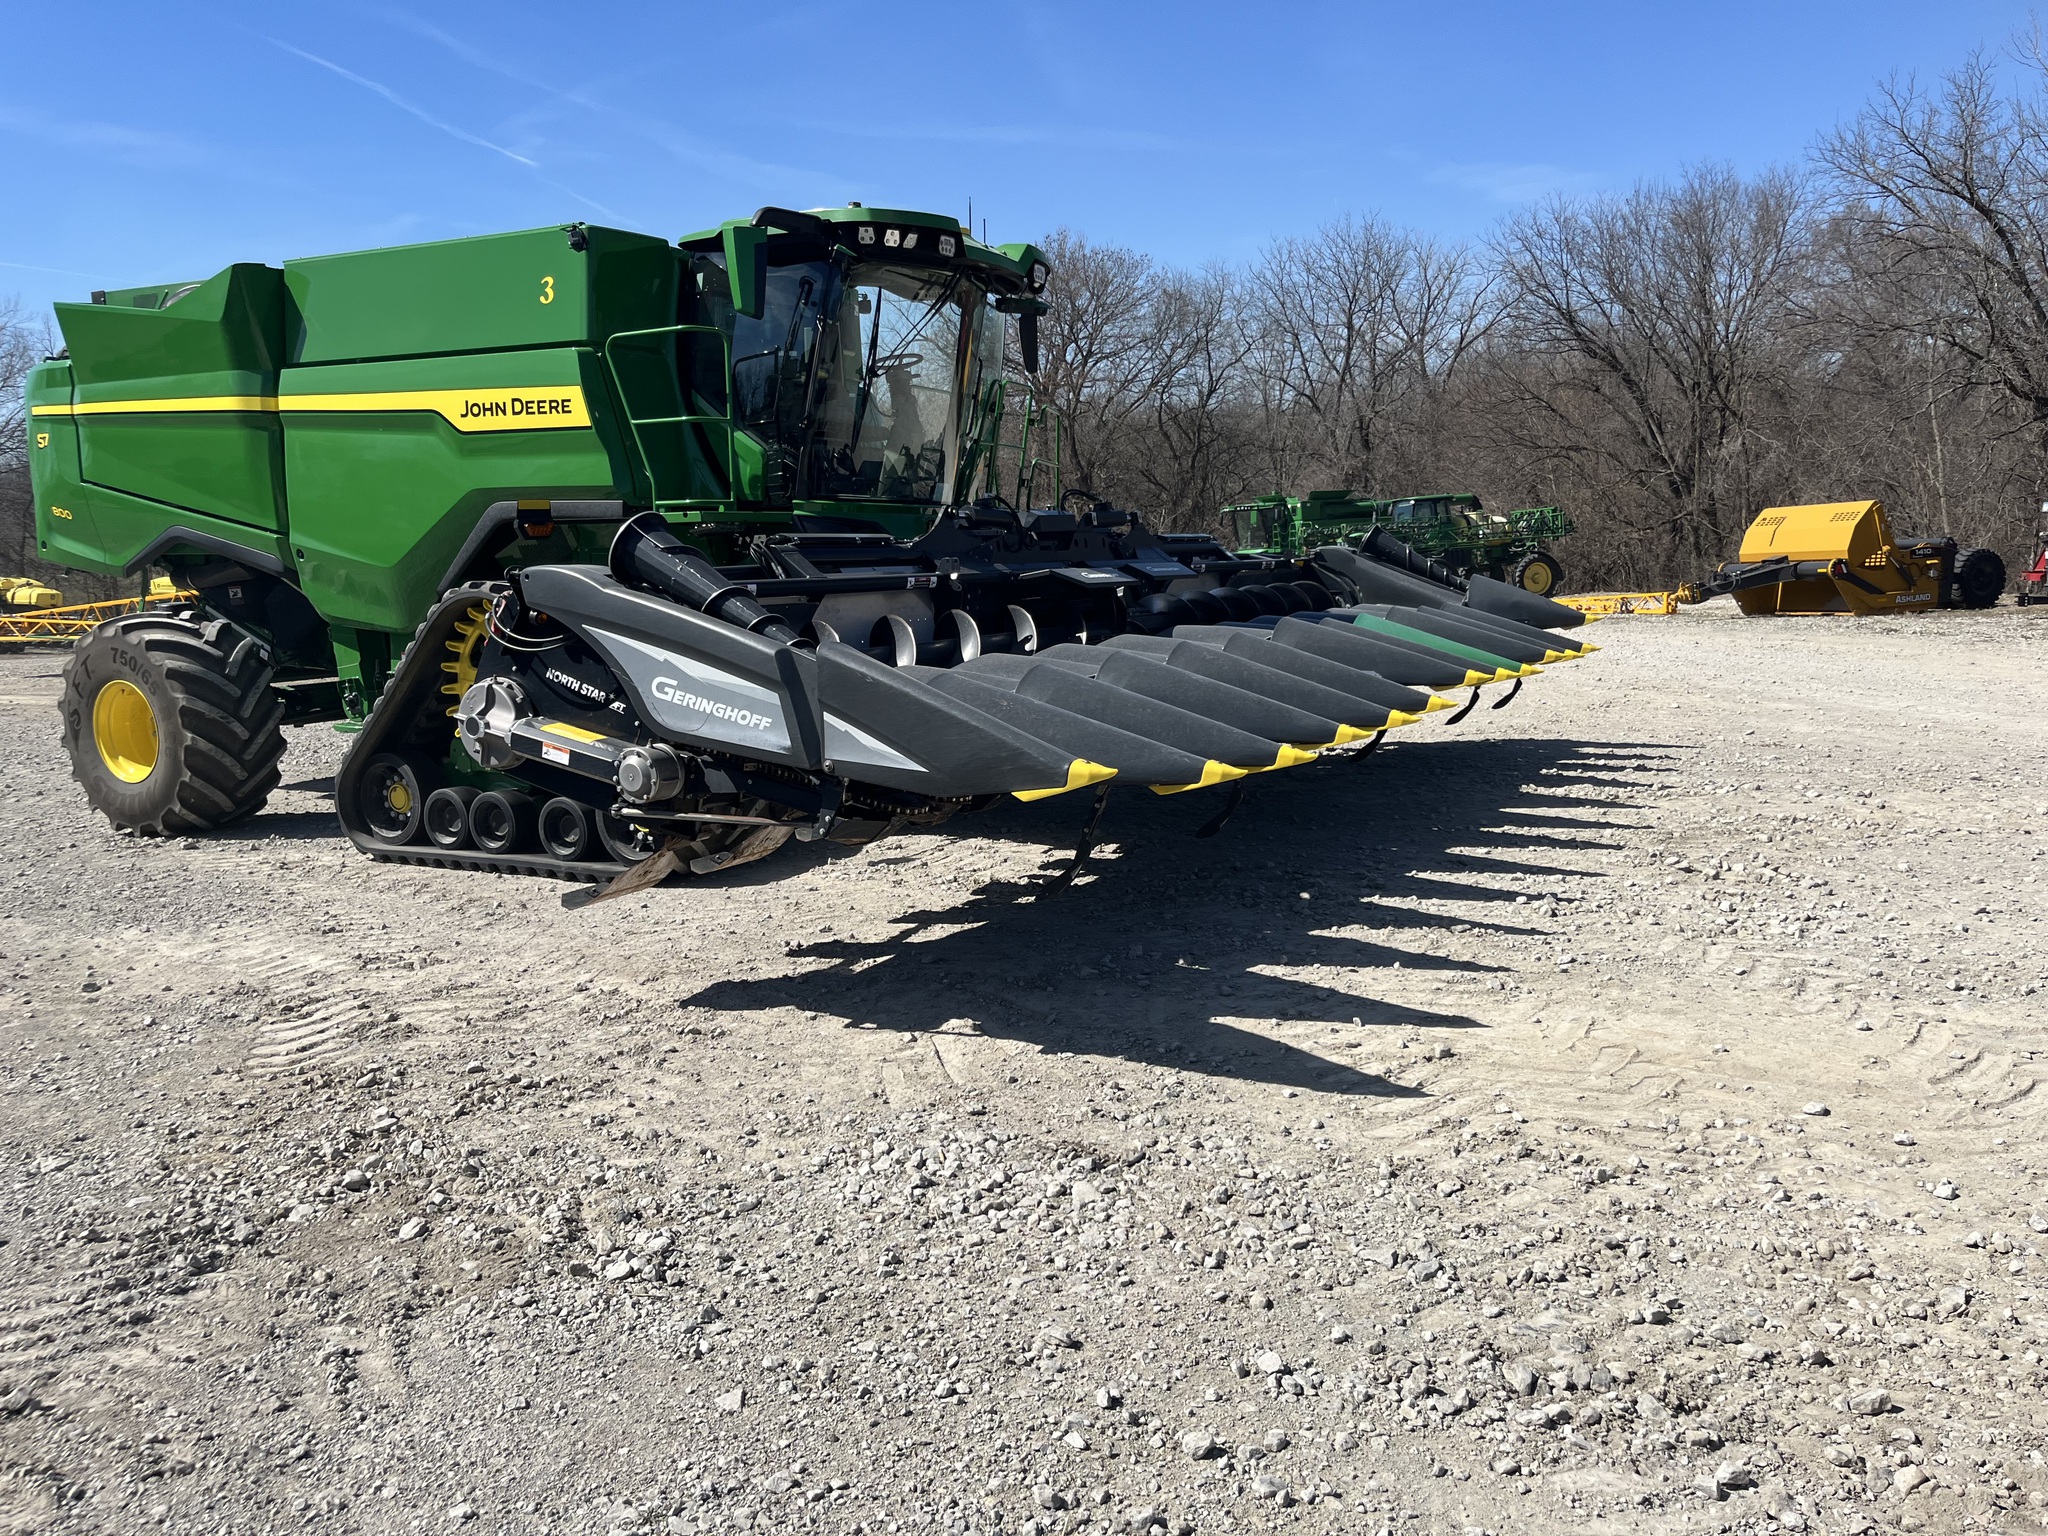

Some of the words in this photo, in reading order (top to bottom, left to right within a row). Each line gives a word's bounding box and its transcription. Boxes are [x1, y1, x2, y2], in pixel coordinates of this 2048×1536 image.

[539, 276, 555, 304] 3
[460, 400, 507, 418] JOHN
[511, 398, 572, 416] DEERE
[37, 433, 49, 449] S7
[51, 506, 73, 520] 800
[1895, 593, 1931, 603] ASHLAND
[110, 647, 157, 696] 750/65
[545, 667, 581, 692] NORTH
[580, 684, 606, 703] STAR
[651, 676, 773, 731] GERINGHOFF
